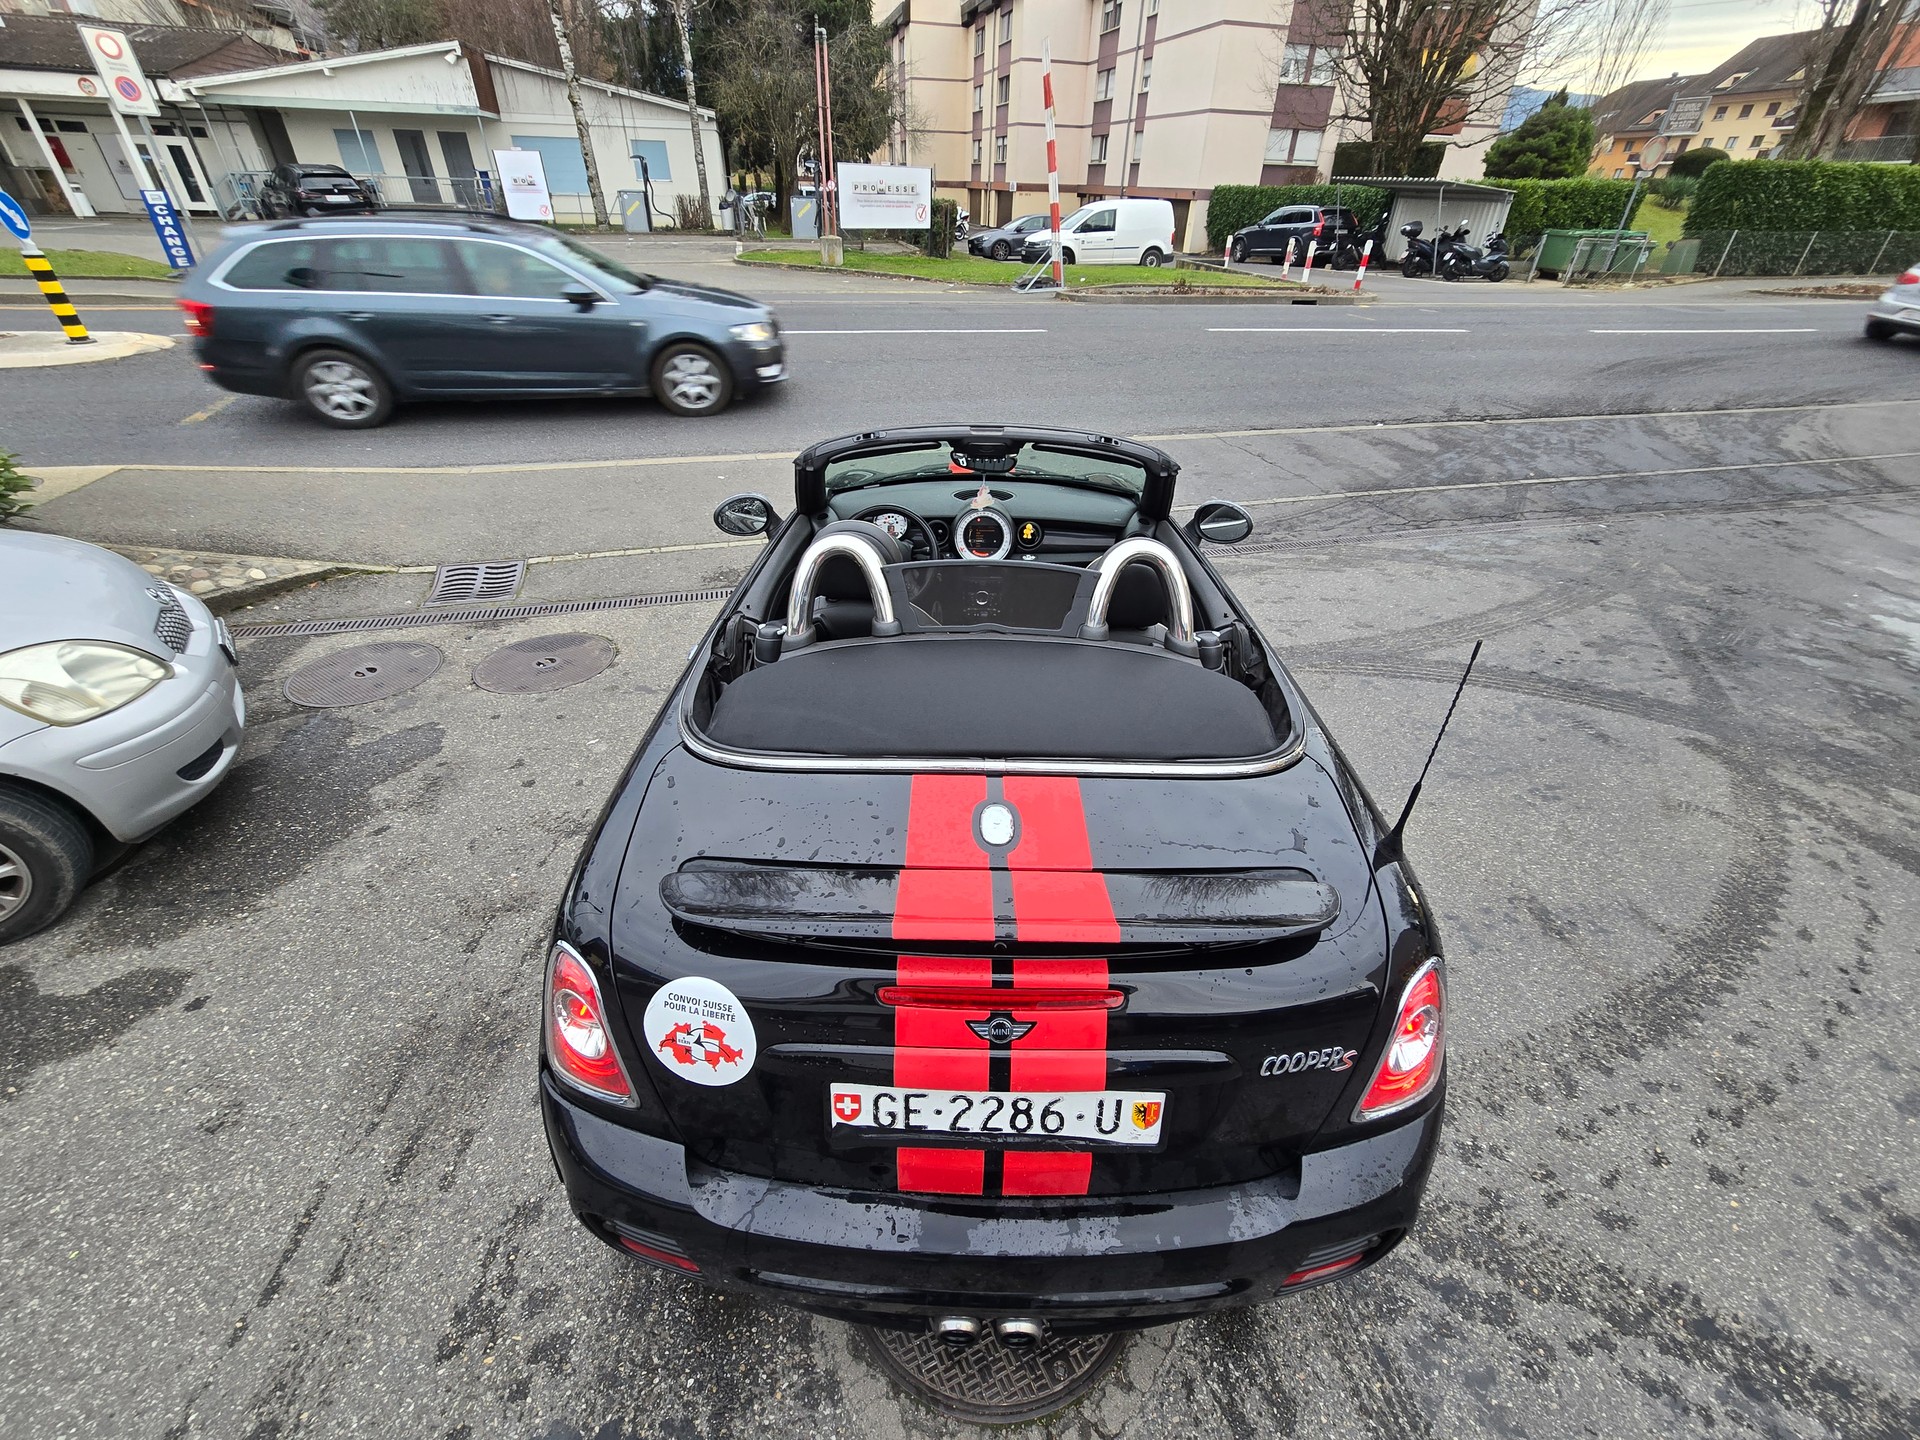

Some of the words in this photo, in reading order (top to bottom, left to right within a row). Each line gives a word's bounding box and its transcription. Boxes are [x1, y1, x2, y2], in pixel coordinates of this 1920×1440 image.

[153, 205, 190, 267] CHANGE
[664, 1000, 687, 1012] POUR
[689, 1006, 700, 1016] LA
[702, 1009, 736, 1023] LIBERTÉ
[668, 992, 701, 1007] CONVOI
[703, 1000, 733, 1013] SUISSE
[991, 1028, 1010, 1036] MINI
